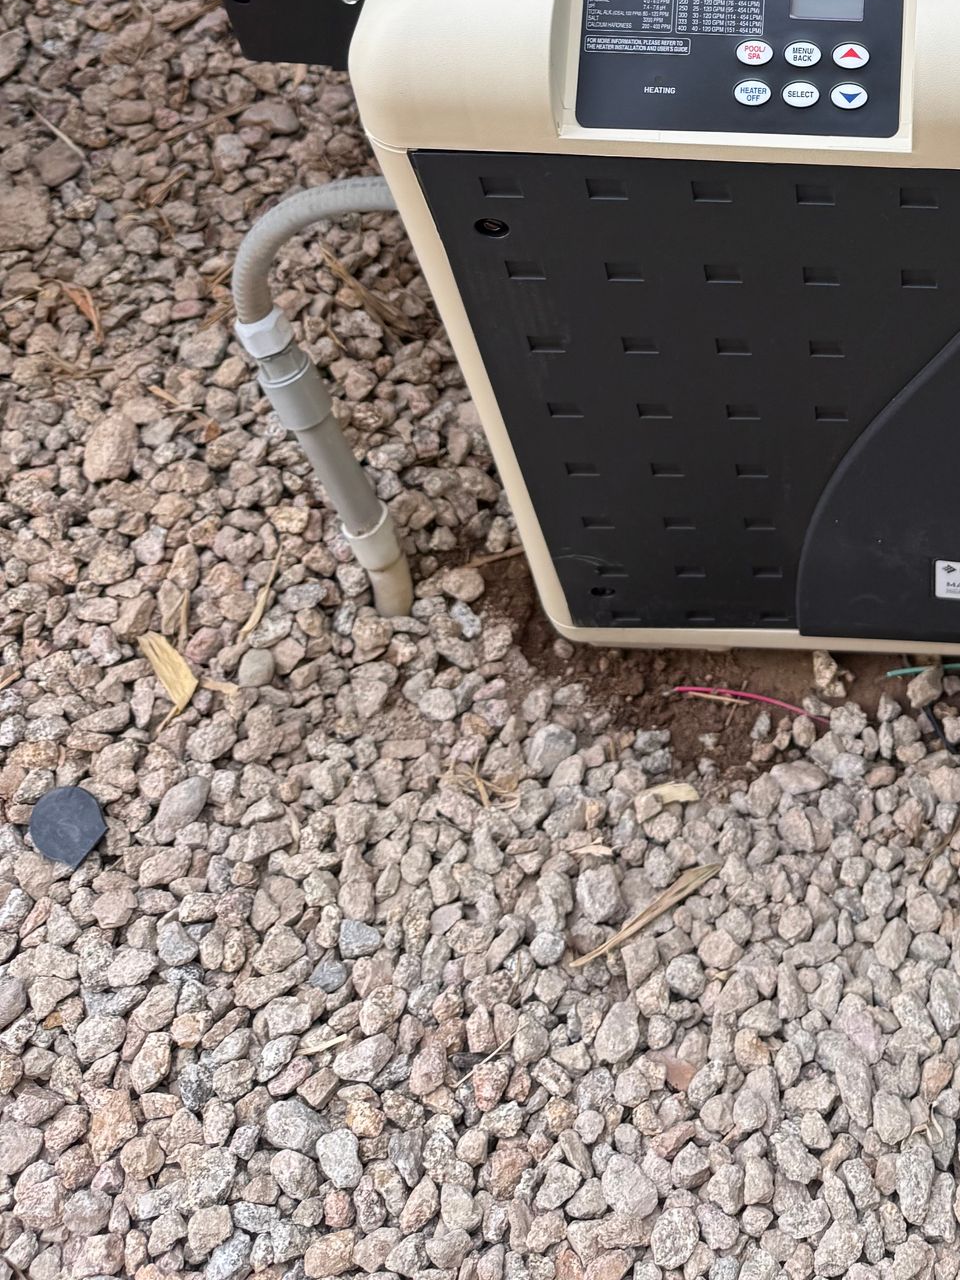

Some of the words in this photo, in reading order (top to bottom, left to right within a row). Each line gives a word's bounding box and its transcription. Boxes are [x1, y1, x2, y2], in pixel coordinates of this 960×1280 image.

[744, 45, 766, 53] POOL/
[644, 86, 676, 94] HEATING
[746, 94, 760, 102] OFF
